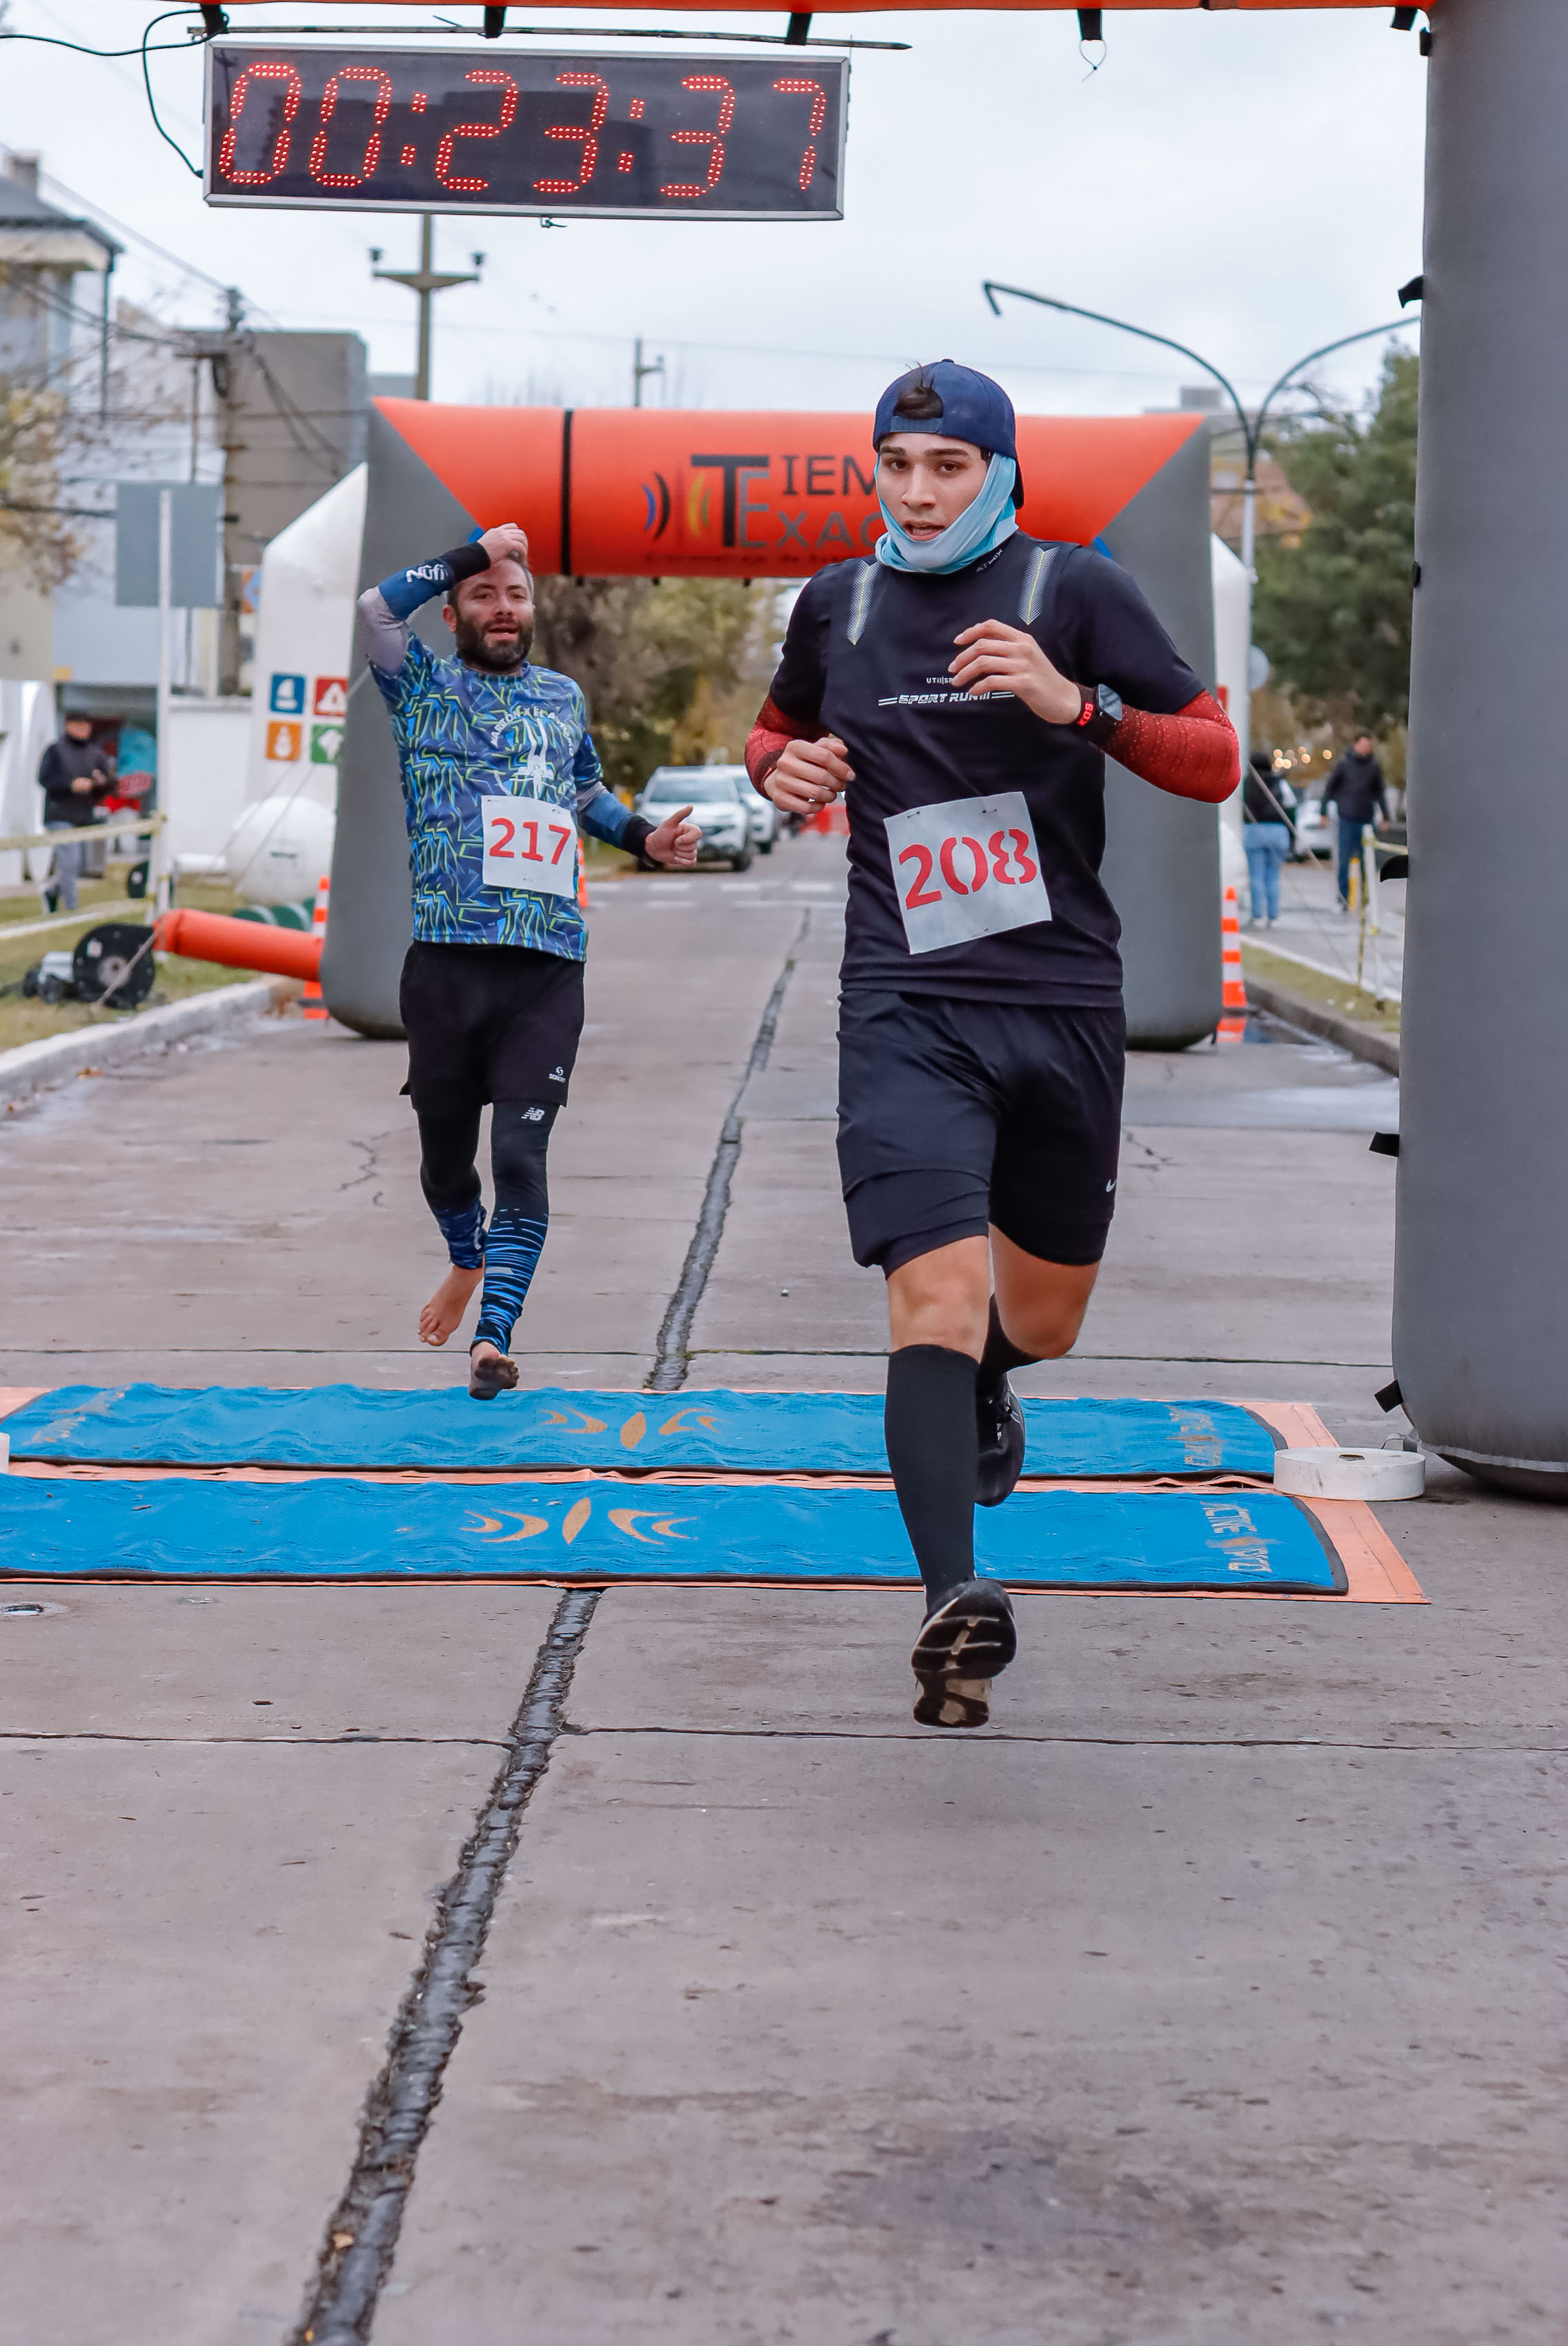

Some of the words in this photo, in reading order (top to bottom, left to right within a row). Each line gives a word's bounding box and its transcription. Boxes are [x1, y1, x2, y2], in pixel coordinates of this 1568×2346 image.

[217, 62, 827, 197] 00:23:37
[898, 693, 948, 704] SPORT
[488, 817, 571, 865] 217
[898, 828, 1038, 911] 208
